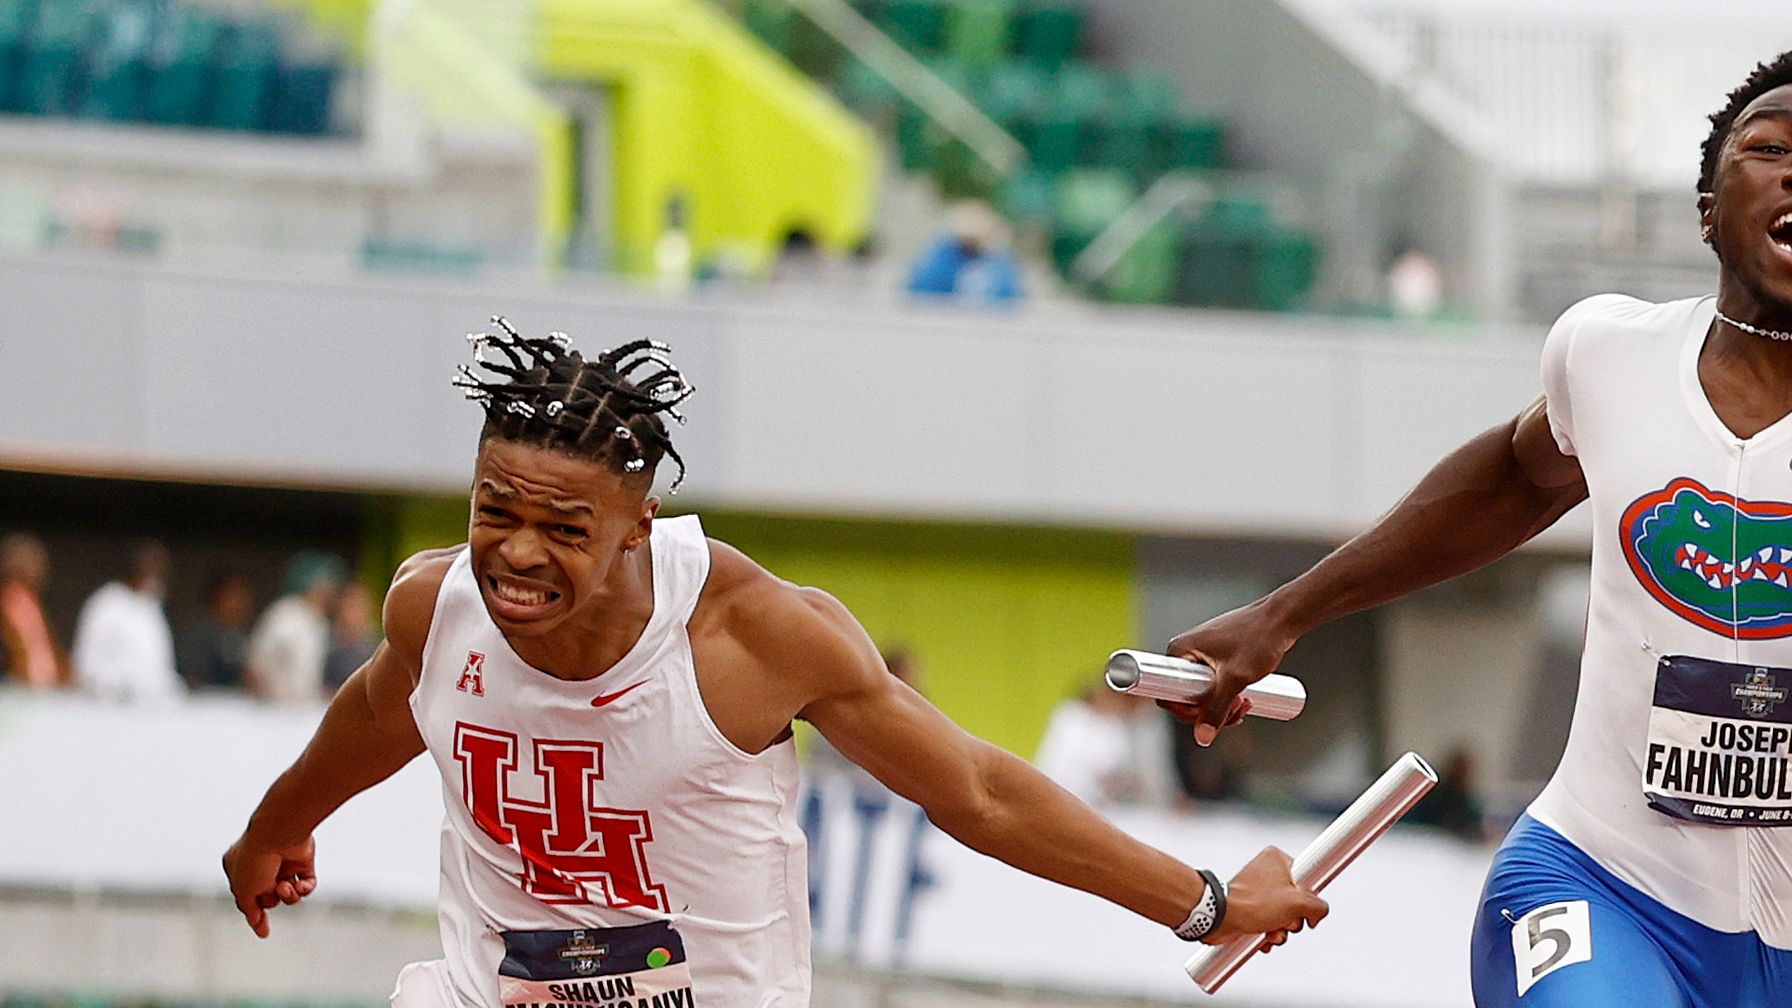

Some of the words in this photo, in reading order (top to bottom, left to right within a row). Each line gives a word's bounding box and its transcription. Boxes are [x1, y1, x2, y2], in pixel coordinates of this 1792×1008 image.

[1692, 803, 1729, 819] EUGENE,
[1730, 808, 1744, 819] OR
[1758, 809, 1782, 820] JUNE
[1527, 906, 1571, 978] 5
[548, 976, 636, 1005] SHAUN
